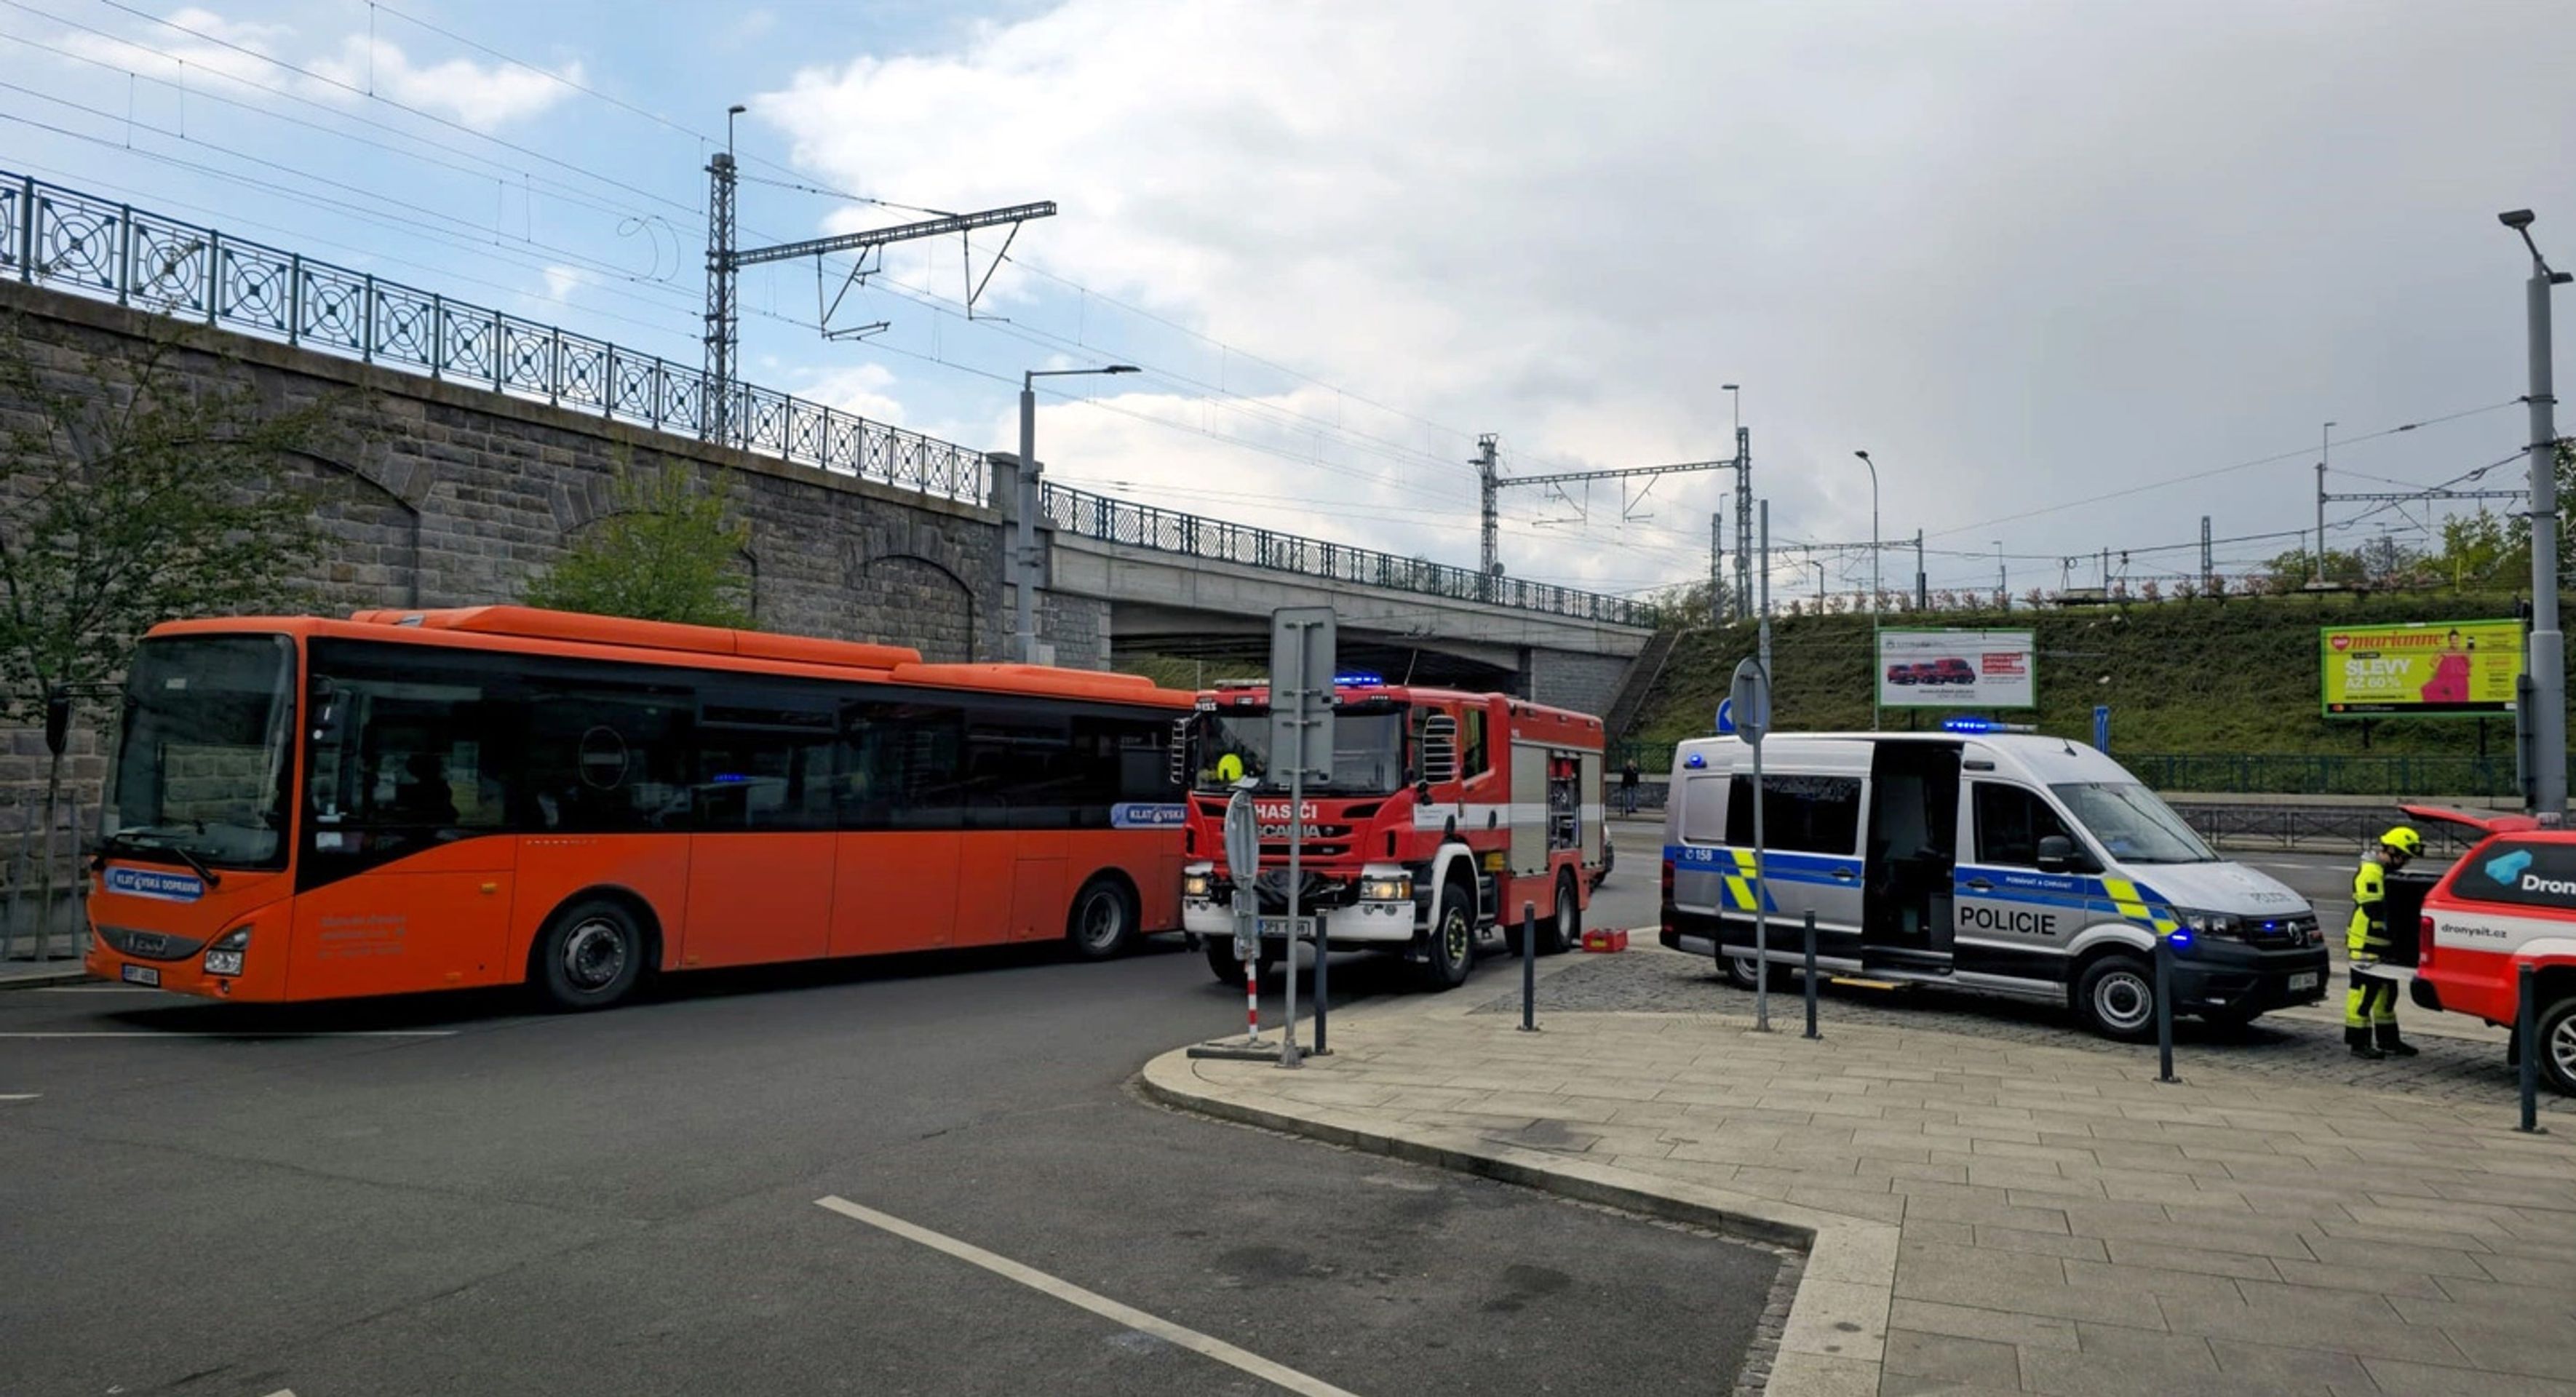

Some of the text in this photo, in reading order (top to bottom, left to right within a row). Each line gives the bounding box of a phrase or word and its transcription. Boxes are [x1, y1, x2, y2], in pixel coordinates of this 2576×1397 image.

[2352, 632, 2442, 649] marianne
[2345, 658, 2411, 675] SLEVY
[2369, 677, 2385, 688] 60
[2388, 677, 2401, 688] %
[1255, 802, 1318, 819] HASČI
[1696, 849, 1713, 861] 158
[2521, 874, 2576, 894] Dron
[1960, 907, 2056, 936] POLICIE
[2441, 923, 2507, 939] dronysit.cz
